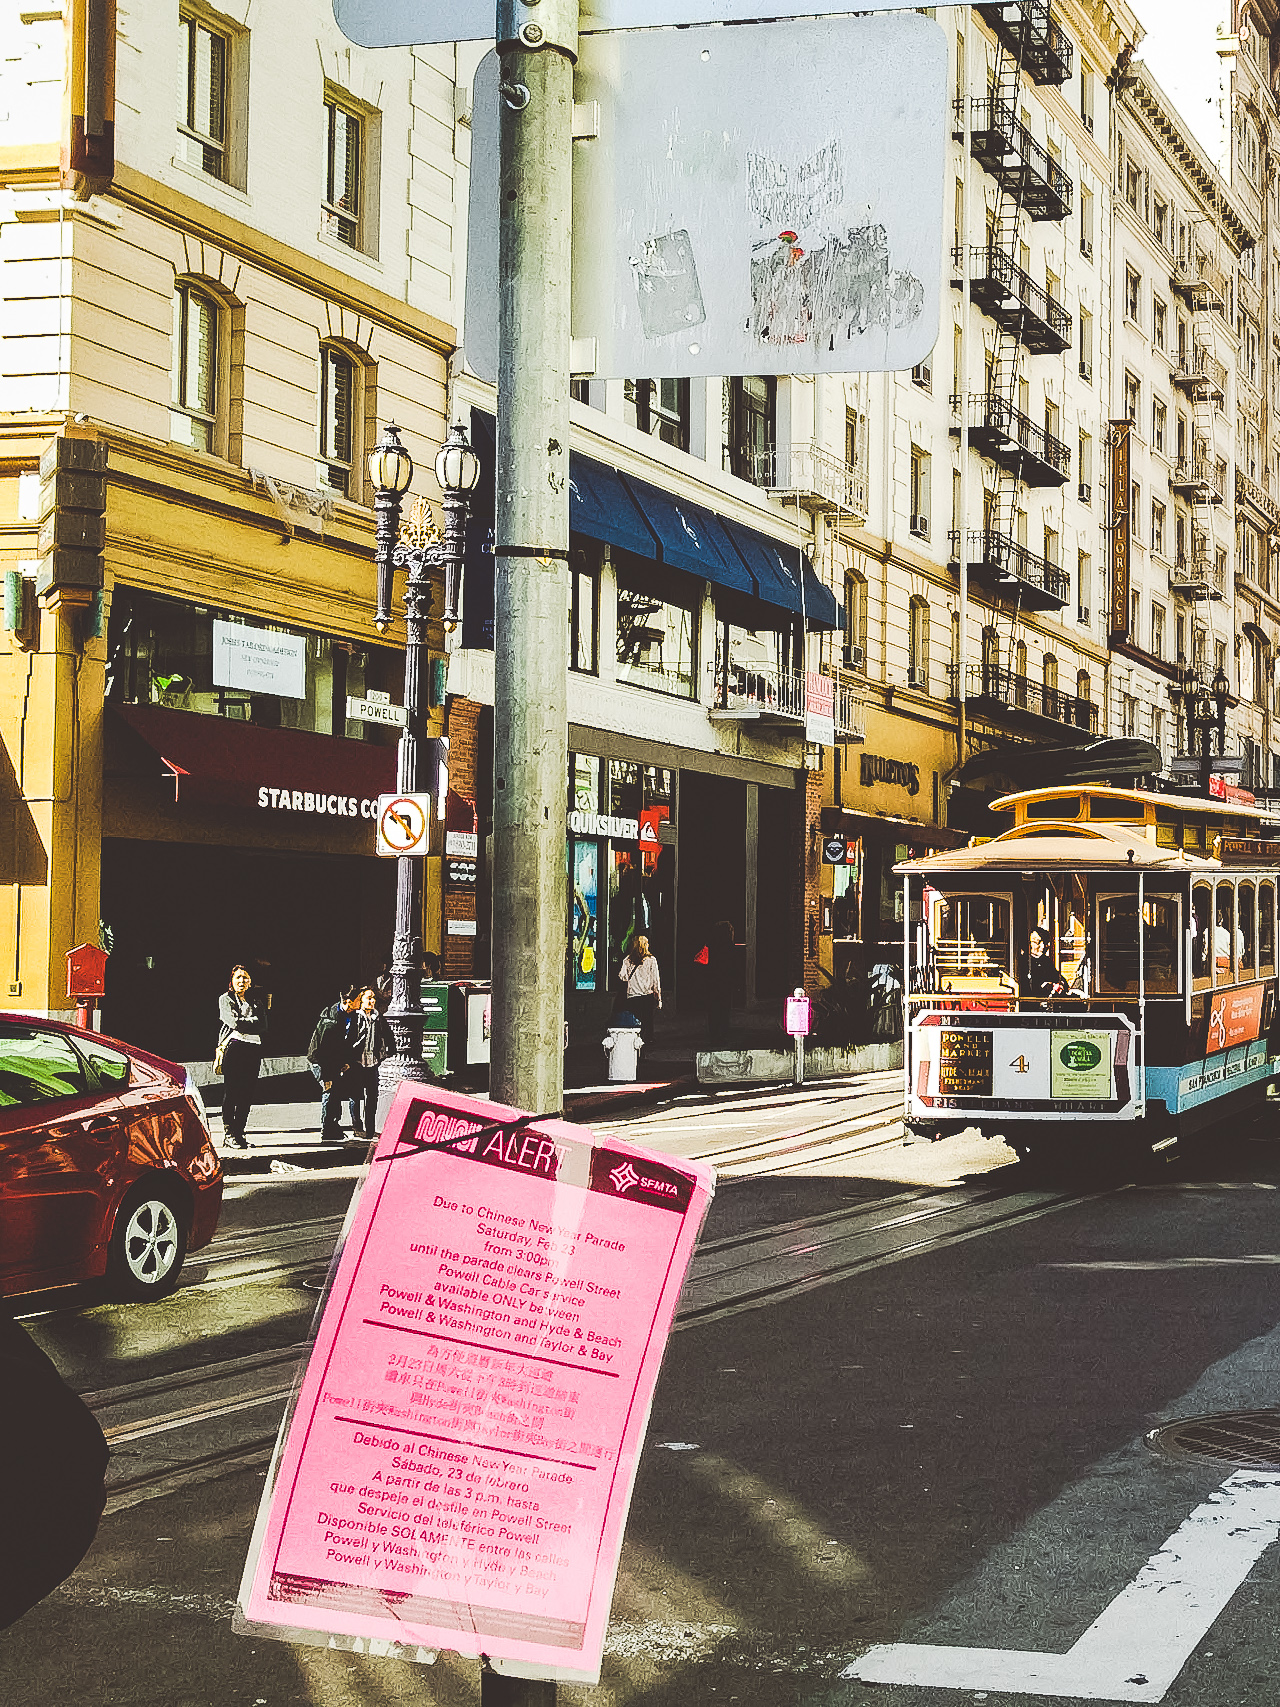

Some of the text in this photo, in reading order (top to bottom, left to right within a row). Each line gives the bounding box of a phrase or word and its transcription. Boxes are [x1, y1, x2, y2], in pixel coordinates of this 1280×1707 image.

[360, 704, 400, 722] POWELL
[257, 786, 358, 818] STARBUCKS
[569, 810, 639, 840] QUIKSILVER
[941, 1048, 991, 1058] MARKET
[942, 1033, 990, 1043] POWELL
[1008, 1054, 1030, 1074] 4
[482, 1130, 572, 1173] ALERT
[640, 1177, 678, 1196] SFMTA
[431, 1194, 460, 1213] Due
[459, 1202, 475, 1215] to
[476, 1207, 527, 1229] Chinese
[528, 1218, 554, 1234] New
[583, 1232, 627, 1252] Parade
[475, 1221, 575, 1258] Saturday, Feb 23
[482, 1240, 513, 1257] from
[409, 1242, 438, 1256] until
[439, 1248, 461, 1262] the
[461, 1253, 504, 1272] parade
[507, 1265, 542, 1281] clears
[585, 1282, 621, 1299] Street
[438, 1264, 480, 1283] Powell
[483, 1274, 517, 1291] Cable
[520, 1283, 541, 1297] Car
[434, 1279, 489, 1303] available
[490, 1293, 527, 1309] ONLY
[380, 1284, 623, 1348] Powell & Washington and Hyde & Beach
[380, 1301, 423, 1320] Powell
[425, 1312, 436, 1323] &
[439, 1314, 511, 1341] Washington
[514, 1333, 538, 1345] and
[576, 1345, 587, 1356] &
[591, 1348, 614, 1364] Bay
[351, 1432, 400, 1453] Debido
[403, 1441, 415, 1455] al
[417, 1444, 470, 1466] Chinese
[470, 1453, 499, 1471] New
[446, 1466, 463, 1481] 23
[465, 1471, 481, 1484] de
[328, 1481, 356, 1496] que
[358, 1483, 409, 1505] despeje
[412, 1496, 424, 1506] el
[472, 1508, 487, 1518] en
[491, 1507, 534, 1528] Powell
[535, 1518, 571, 1534] Street
[371, 1471, 383, 1483] A
[386, 1473, 421, 1489] partir
[422, 1479, 440, 1493] de
[443, 1483, 462, 1496] las
[464, 1487, 474, 1498] 3
[507, 1495, 540, 1513] hasta
[315, 1511, 389, 1542] Disponible
[477, 1542, 512, 1559] entre
[357, 1502, 410, 1525] Servicio
[413, 1513, 433, 1528] del
[498, 1526, 539, 1544] Powell
[324, 1529, 370, 1550] Powell
[371, 1541, 382, 1555] y
[325, 1549, 373, 1569] Powell
[372, 1557, 382, 1571] y
